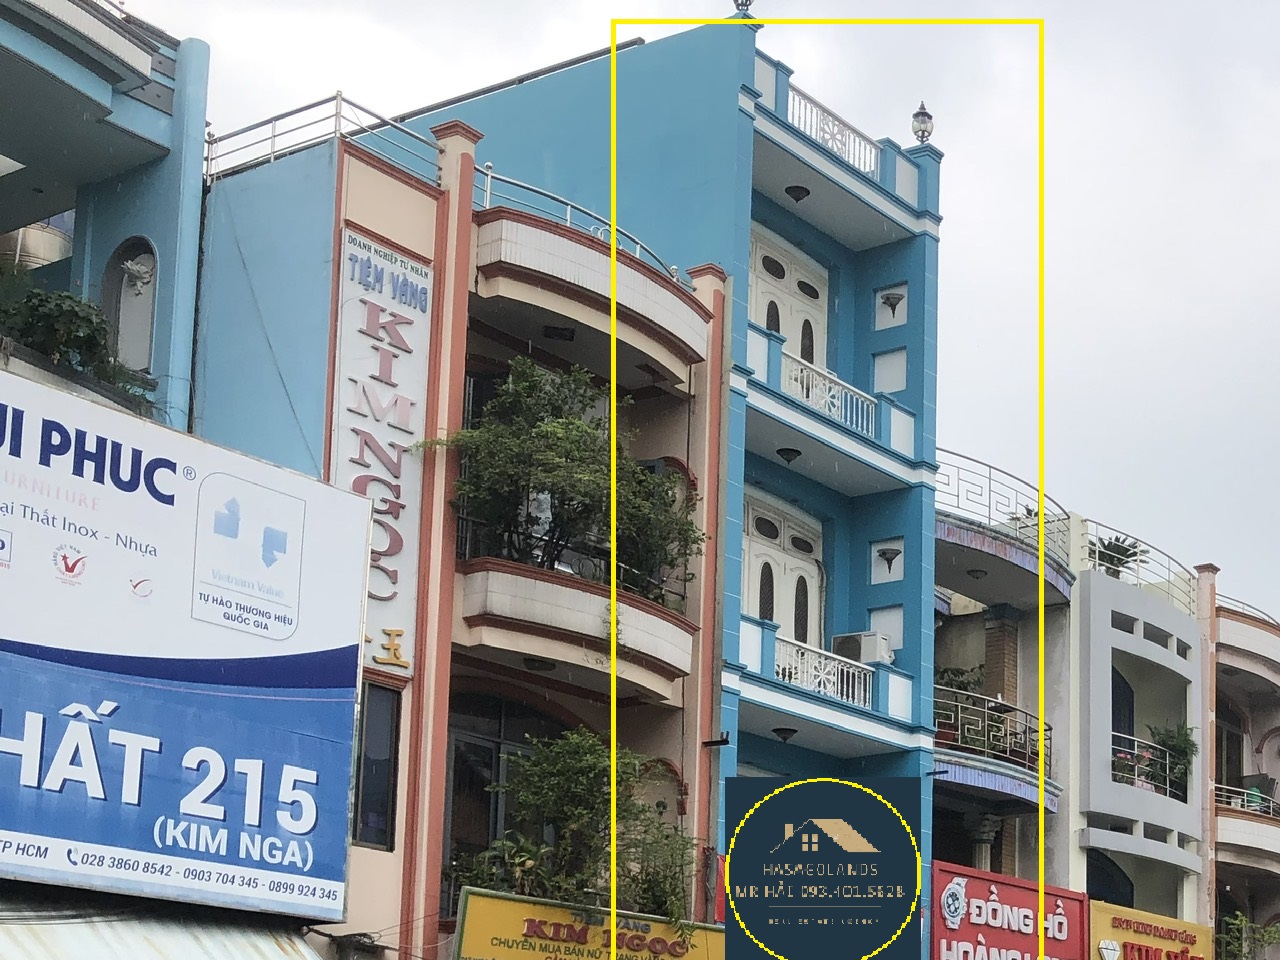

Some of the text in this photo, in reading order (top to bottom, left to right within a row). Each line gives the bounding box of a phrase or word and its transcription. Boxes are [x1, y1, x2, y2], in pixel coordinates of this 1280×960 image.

[347, 234, 430, 280] DOANH NGHIỆP TƯ NHÂN
[347, 252, 429, 313] TIỆM VÀNG
[0, 403, 178, 506] I PHUC
[20, 503, 58, 528] Thất
[62, 516, 99, 541] Inox
[115, 532, 158, 558] Nhựa
[211, 568, 255, 590] Vietnam
[198, 592, 293, 627] TỰ HÀO THƯƠNG HIỆU
[222, 611, 270, 632] QUỐC GIA
[180, 745, 320, 836] 215
[152, 815, 315, 873] (KIM NGA)
[14, 842, 50, 860] HCM
[80, 852, 106, 868] 028
[106, 855, 141, 873] 3860
[142, 859, 173, 878] 8542
[182, 867, 213, 884] 0903
[213, 871, 237, 887] 704
[237, 873, 261, 890] 345
[267, 880, 296, 896] 0899
[296, 883, 318, 899] 924
[317, 886, 339, 902] 345
[521, 917, 590, 946] KIM
[968, 884, 1035, 935] ĐỒNG
[490, 937, 536, 952] CHUYÊN
[538, 943, 564, 955] MUA
[564, 942, 585, 958] BÁN
